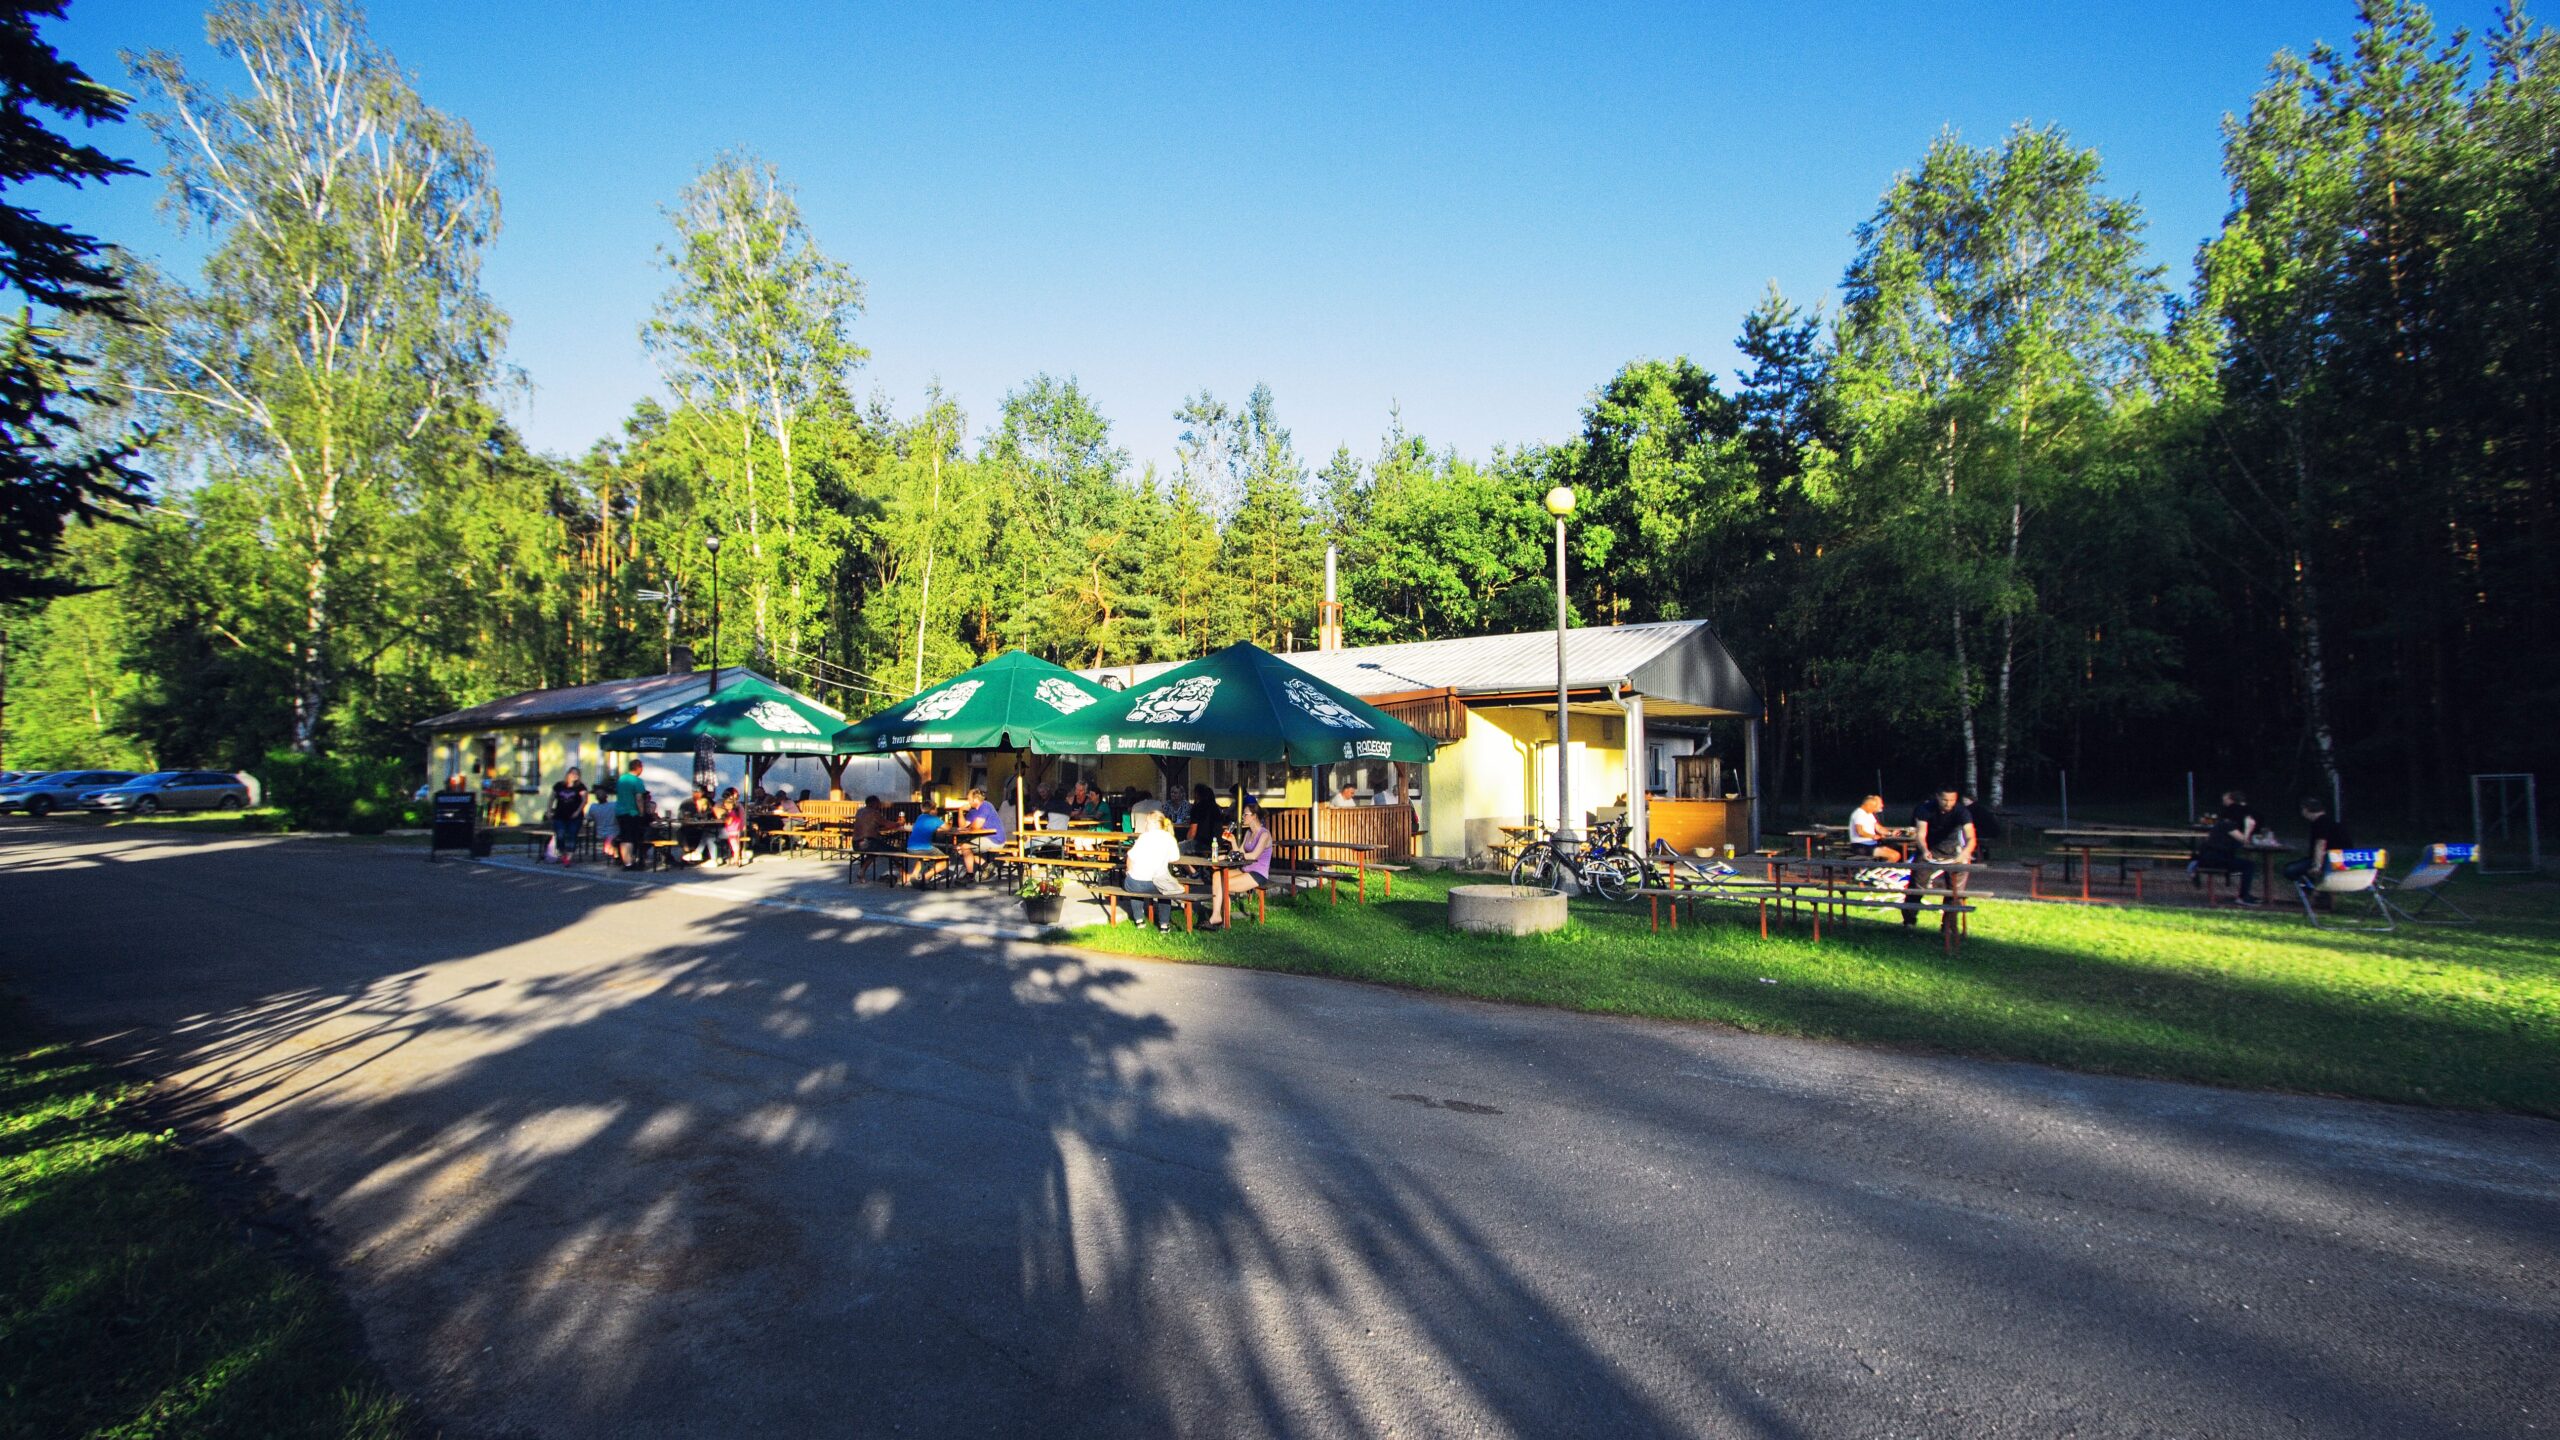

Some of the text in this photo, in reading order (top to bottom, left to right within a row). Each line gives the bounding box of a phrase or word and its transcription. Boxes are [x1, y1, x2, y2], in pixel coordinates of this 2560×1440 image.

[1118, 738, 1206, 752] ŽIVOT JE HOŘKÝ. BOHUDÍK!
[1356, 740, 1392, 758] RADEGAST
